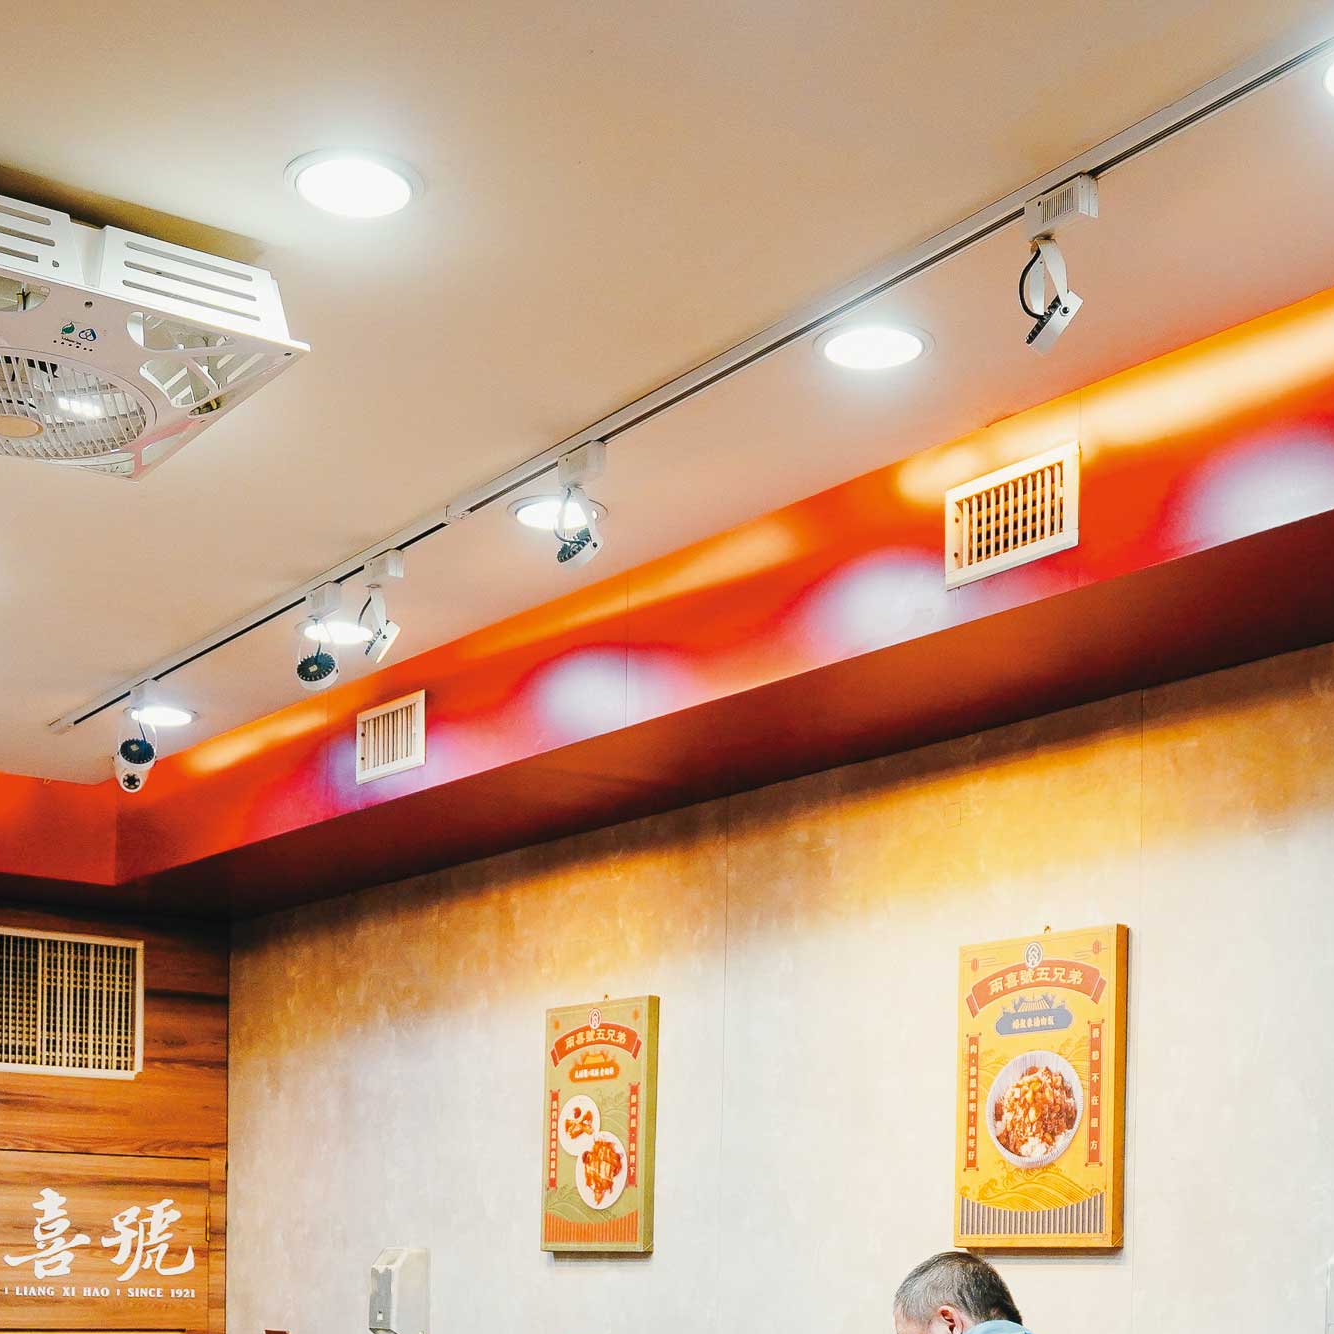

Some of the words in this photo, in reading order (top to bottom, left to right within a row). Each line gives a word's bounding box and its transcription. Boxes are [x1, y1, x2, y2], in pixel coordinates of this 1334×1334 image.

[988, 967, 1084, 996] 兩喜號五兄弟
[565, 1028, 627, 1050] 兩喜號五兄弟
[15, 1286, 55, 1297] LIANG
[61, 1286, 76, 1297] XI
[82, 1287, 110, 1298] HAO
[127, 1287, 163, 1298] SINCE
[169, 1288, 196, 1299] 1921
